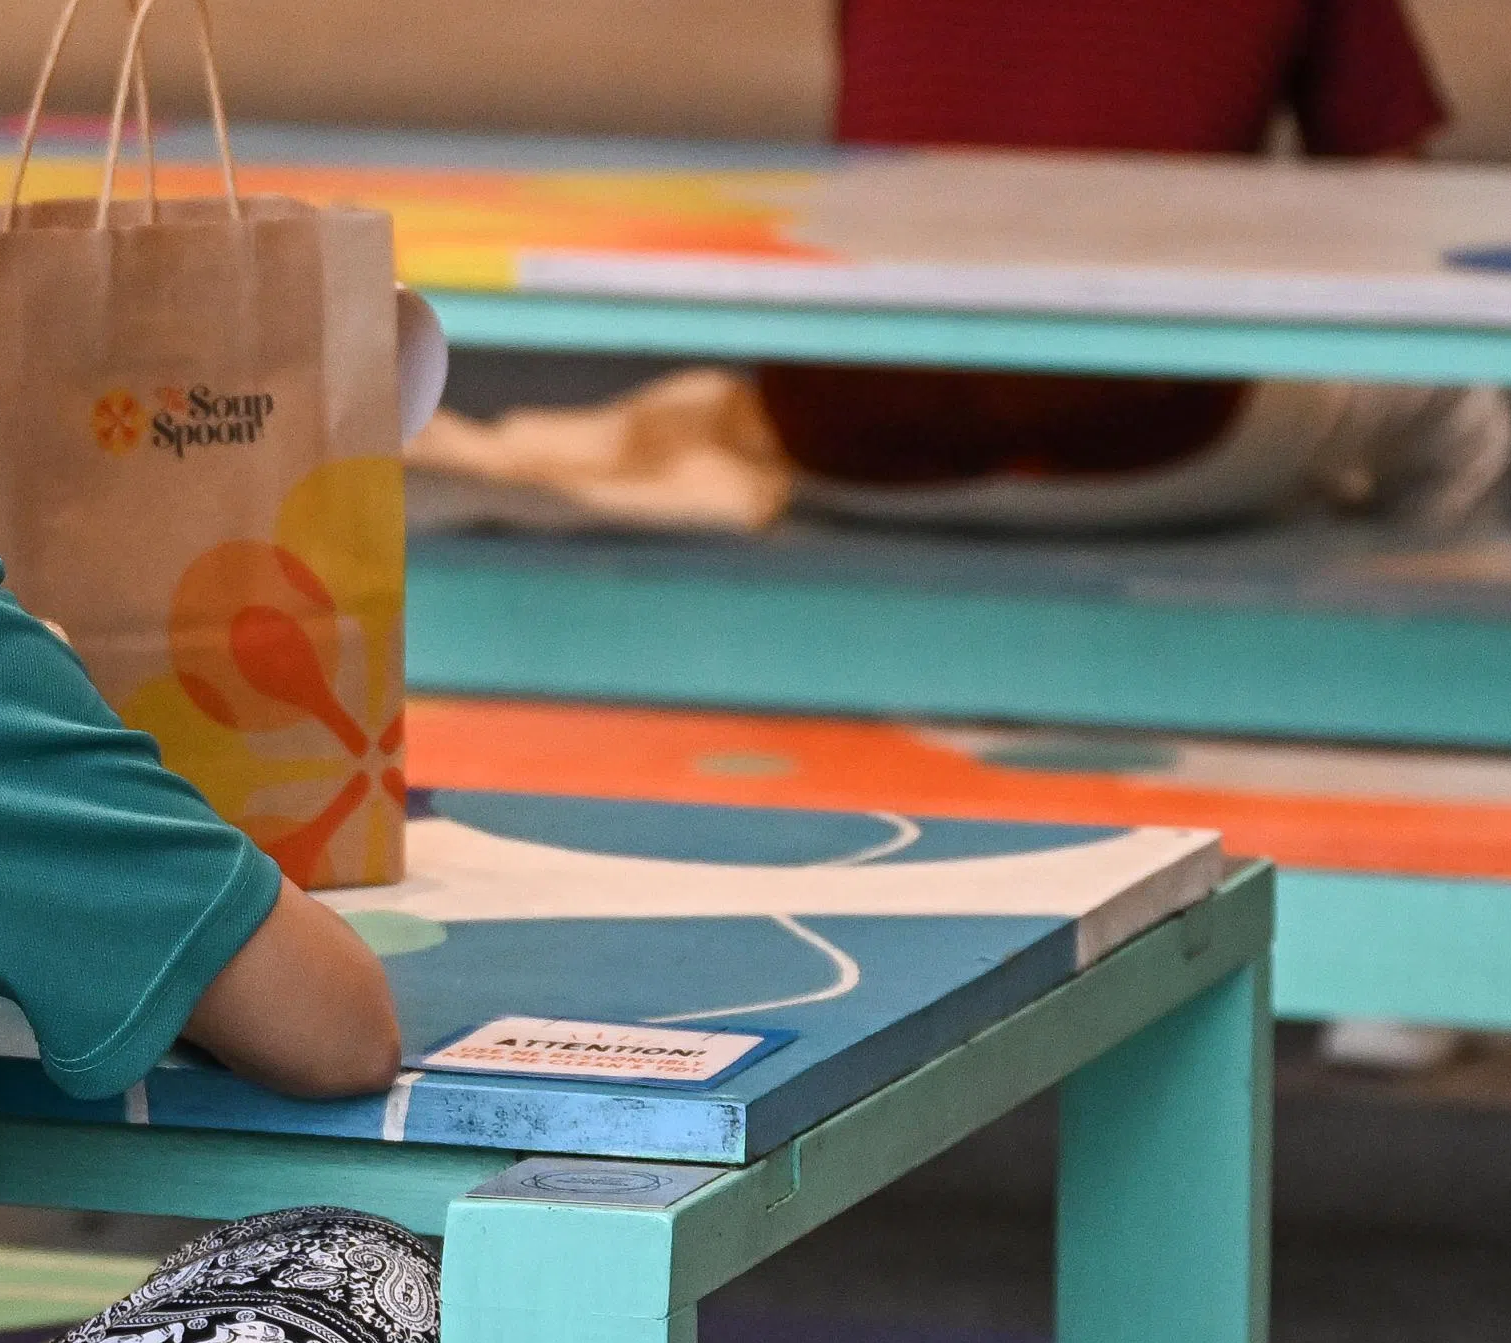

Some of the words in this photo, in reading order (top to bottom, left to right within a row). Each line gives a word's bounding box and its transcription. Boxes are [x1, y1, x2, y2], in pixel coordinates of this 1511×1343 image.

[189, 383, 274, 428] Soup
[153, 411, 256, 458] Spoon
[495, 1038, 707, 1058] ATTENTION!
